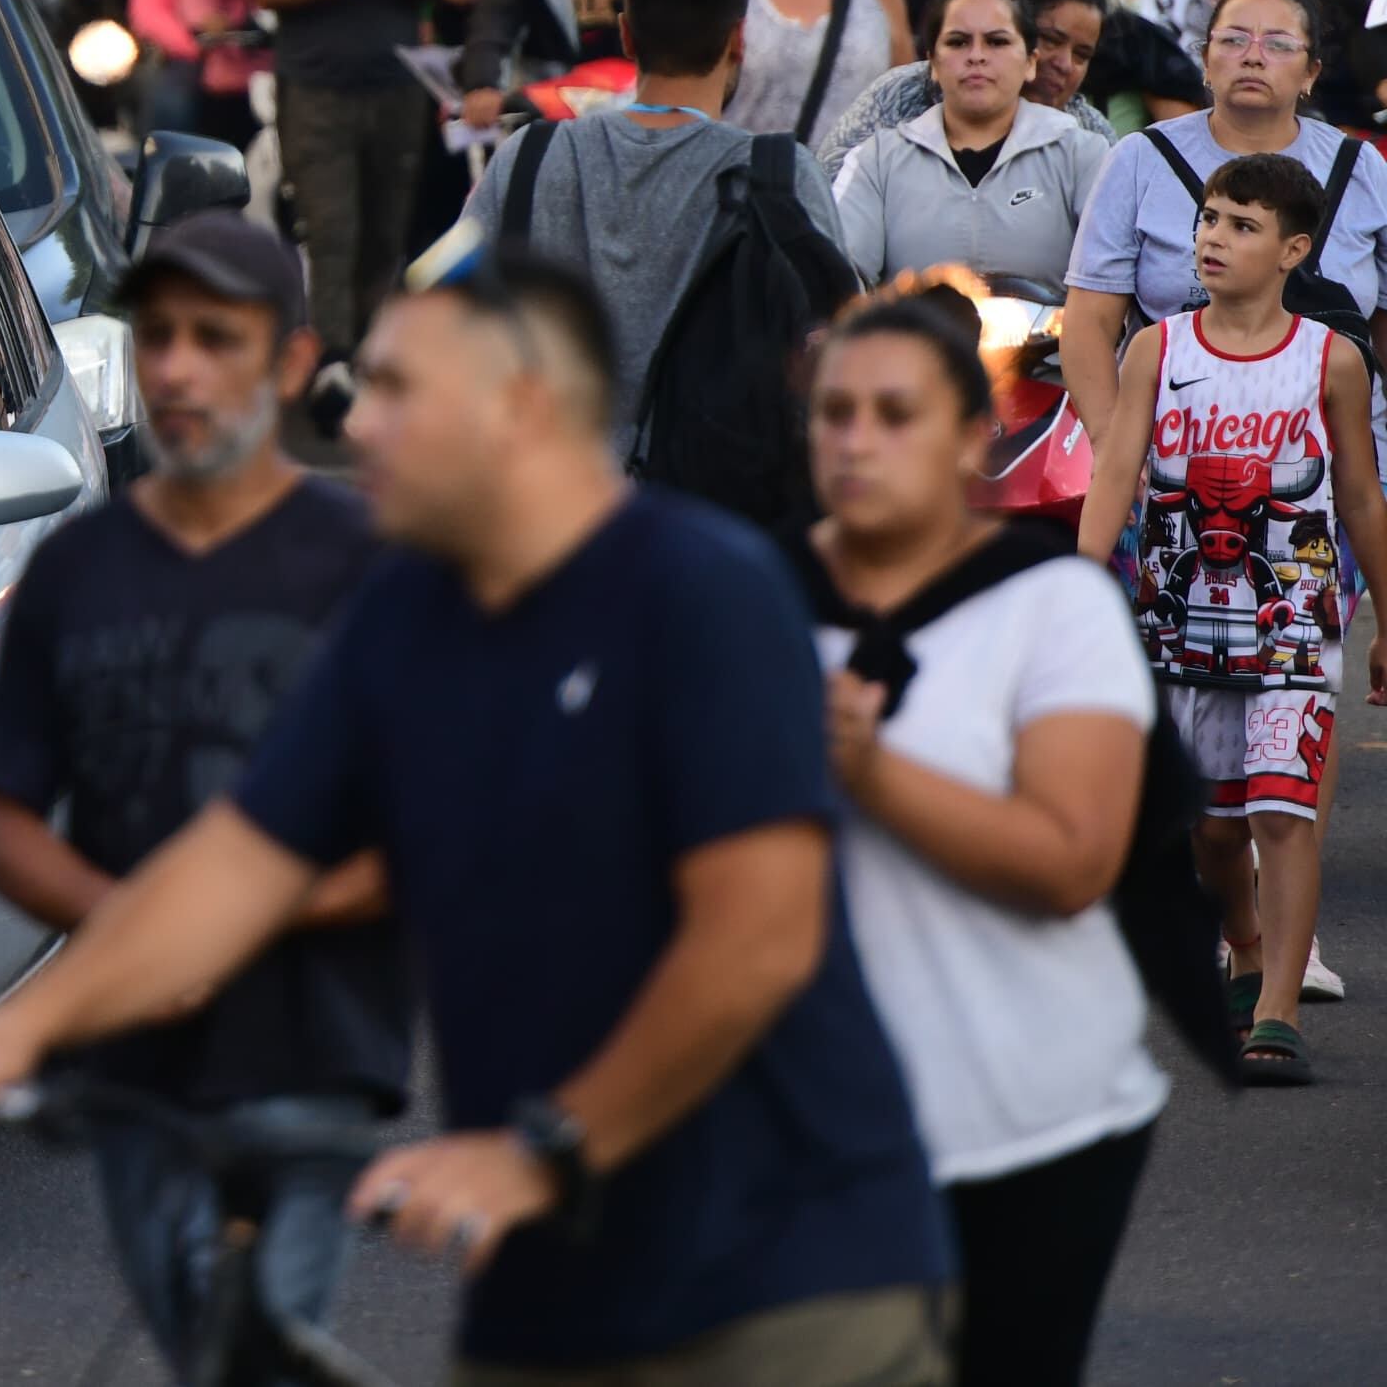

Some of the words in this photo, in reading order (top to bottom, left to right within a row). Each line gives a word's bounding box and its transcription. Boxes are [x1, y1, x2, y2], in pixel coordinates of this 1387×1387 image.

[1156, 404, 1310, 480] Chicago
[1209, 587, 1231, 606] 24
[1243, 706, 1304, 764] 23
